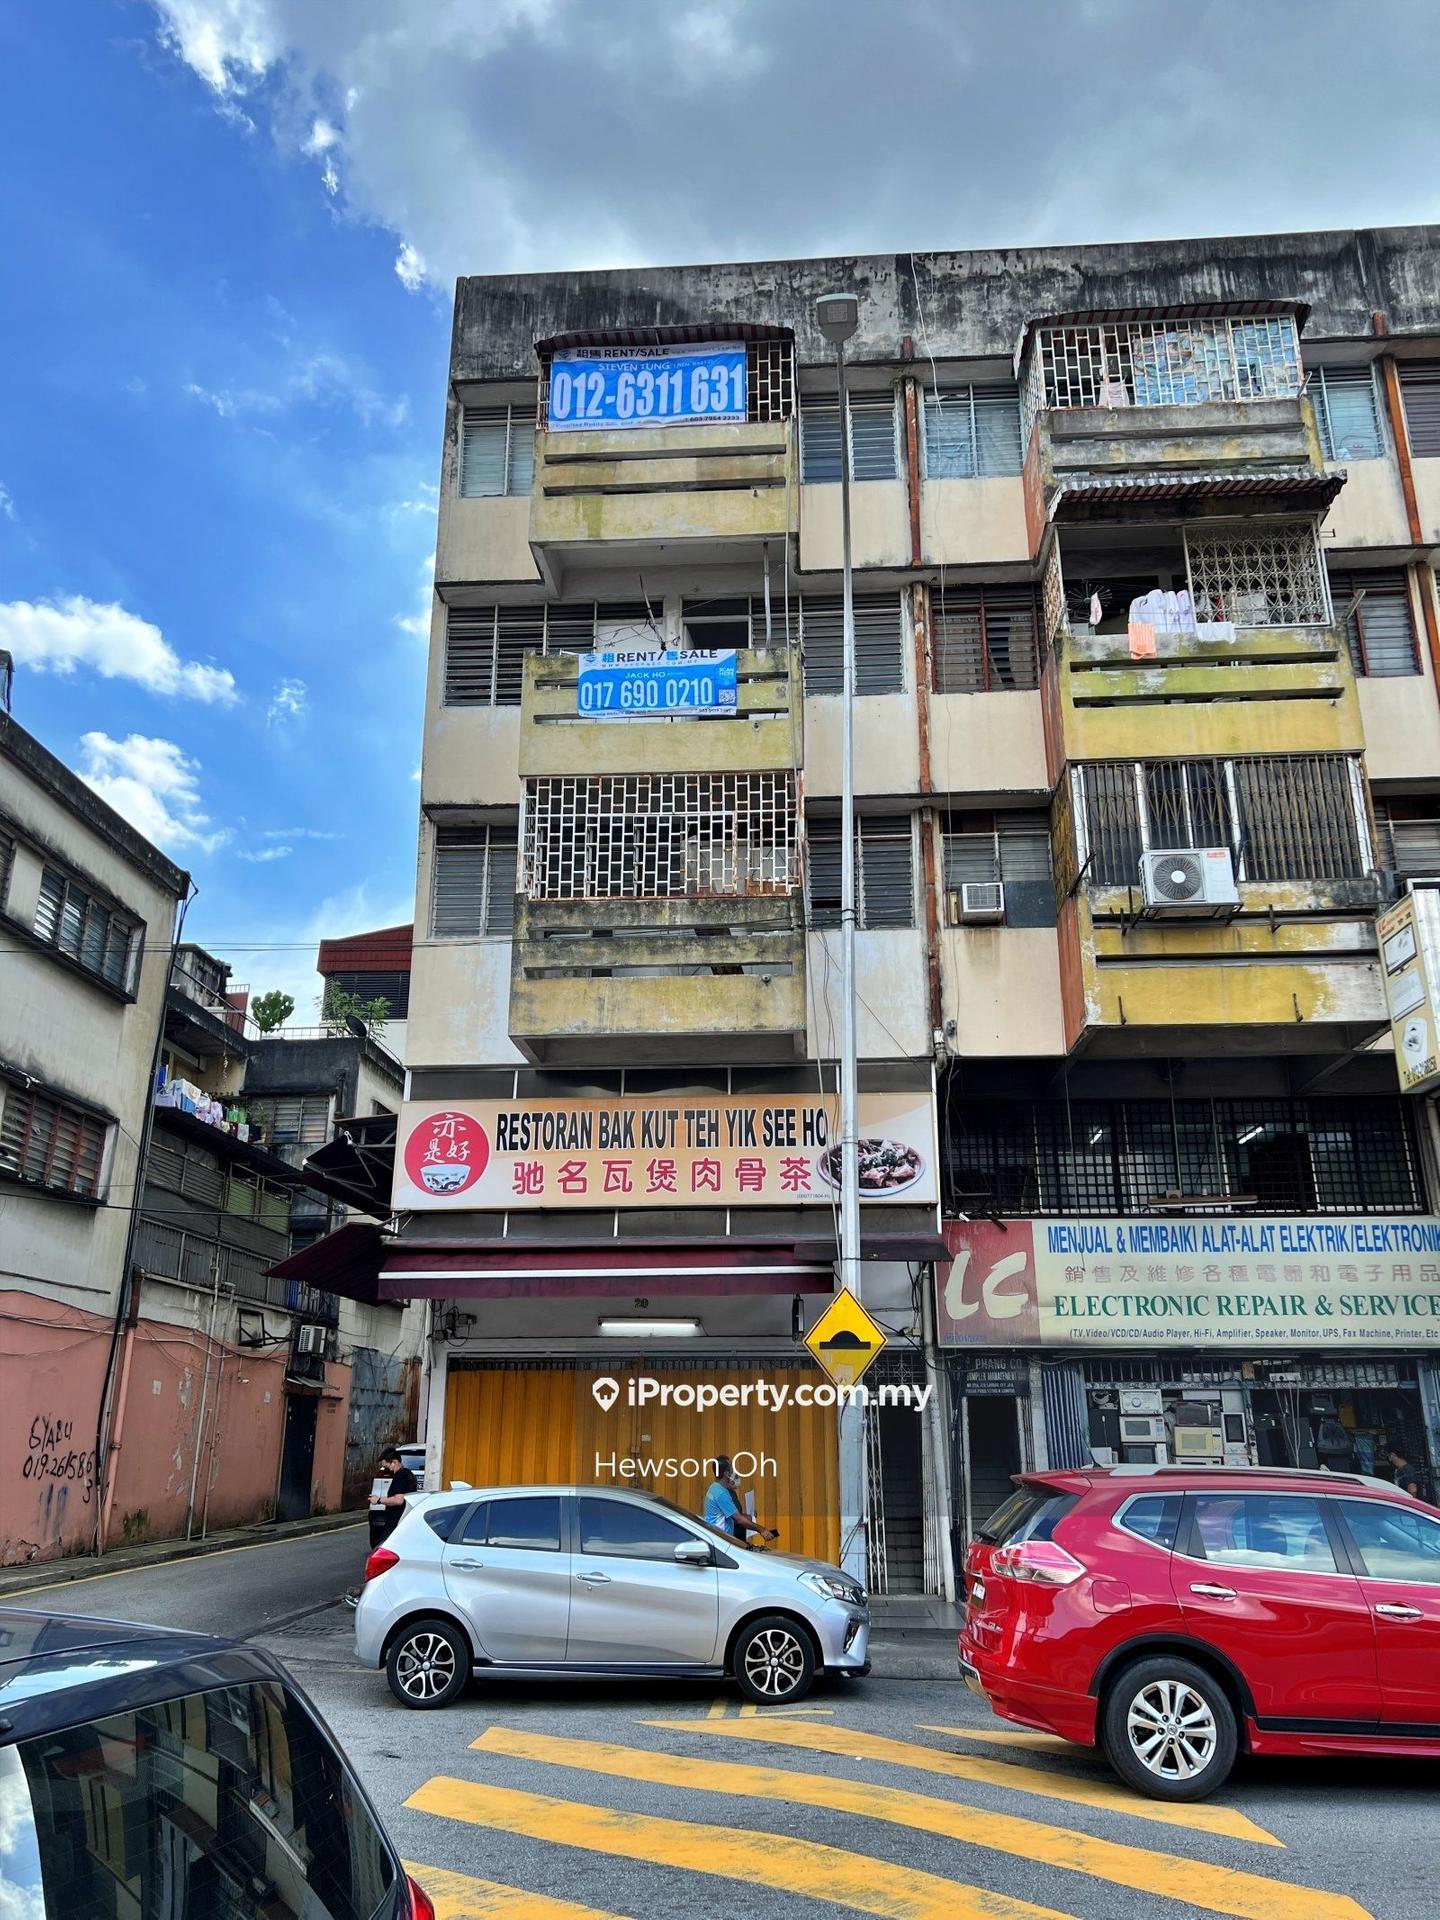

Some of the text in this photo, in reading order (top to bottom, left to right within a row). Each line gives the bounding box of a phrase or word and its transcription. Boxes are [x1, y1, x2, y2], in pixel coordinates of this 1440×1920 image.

[604, 348, 670, 358] RENT/SALE
[598, 363, 638, 371] STEVEN
[553, 364, 743, 419] 012-6311 631
[680, 649, 718, 659] SALE
[581, 677, 713, 709] 017 690 0210
[431, 1113, 467, 1138] 亦
[496, 1108, 828, 1151] RESTORAN BAK KUT TEH YIK SEE HO
[423, 1138, 471, 1164] 是好
[512, 1156, 811, 1195] 驰名瓦煲肉骨茶
[1048, 1225, 1112, 1253] MENJUAL
[1116, 1226, 1126, 1253] &
[1129, 1225, 1196, 1253] MEMBAIKI
[1202, 1224, 1275, 1252] ALAT-ALAT
[1053, 1294, 1440, 1317] ELECTRONIC REPAIR & SERVICE
[1167, 1328, 1192, 1339] Player,
[1217, 1328, 1253, 1339] Amplifier,
[1255, 1328, 1288, 1339] Speaker,
[1342, 1328, 1356, 1337] Fax
[1359, 1328, 1393, 1339] Machine,
[1395, 1328, 1425, 1338] Printer,
